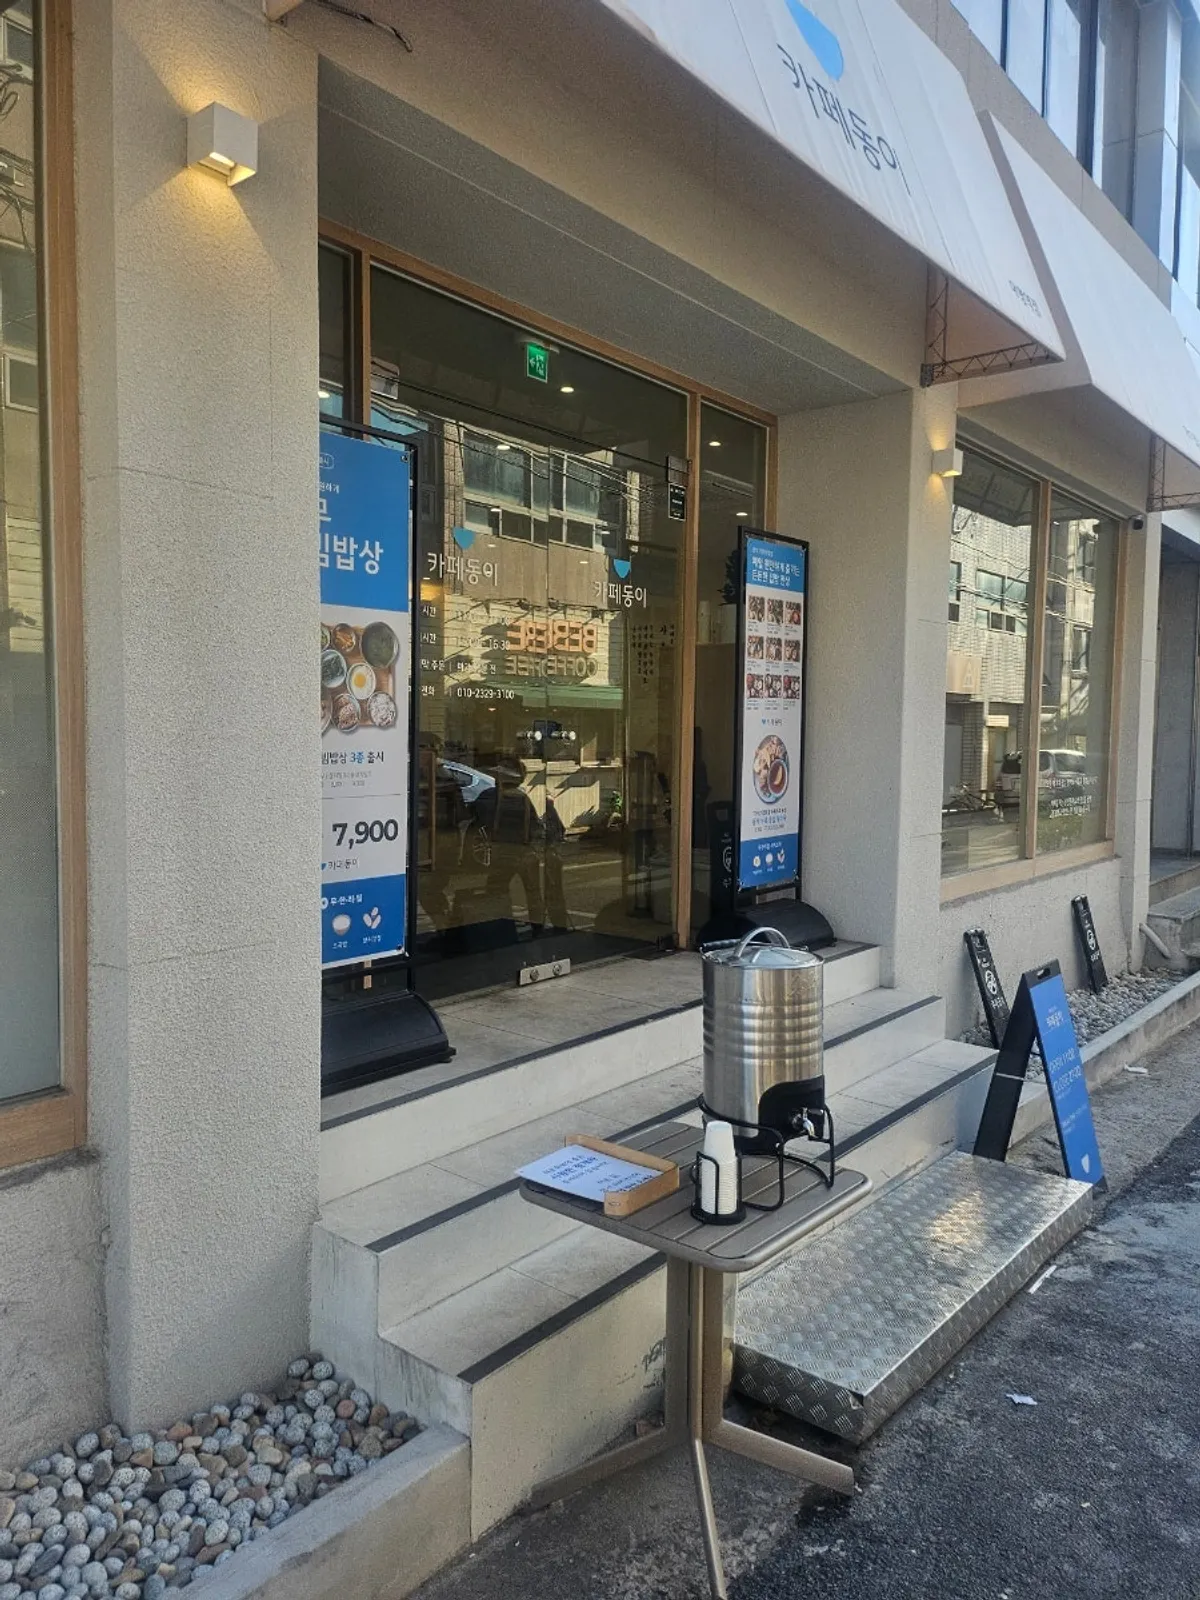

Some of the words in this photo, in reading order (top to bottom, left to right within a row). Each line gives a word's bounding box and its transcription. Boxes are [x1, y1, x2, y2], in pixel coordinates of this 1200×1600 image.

[777, 43, 911, 197] 카페동이
[427, 552, 498, 587] 카페동이
[595, 581, 647, 608] 카페동이
[367, 750, 384, 764] 출시
[332, 818, 399, 849] 7,900
